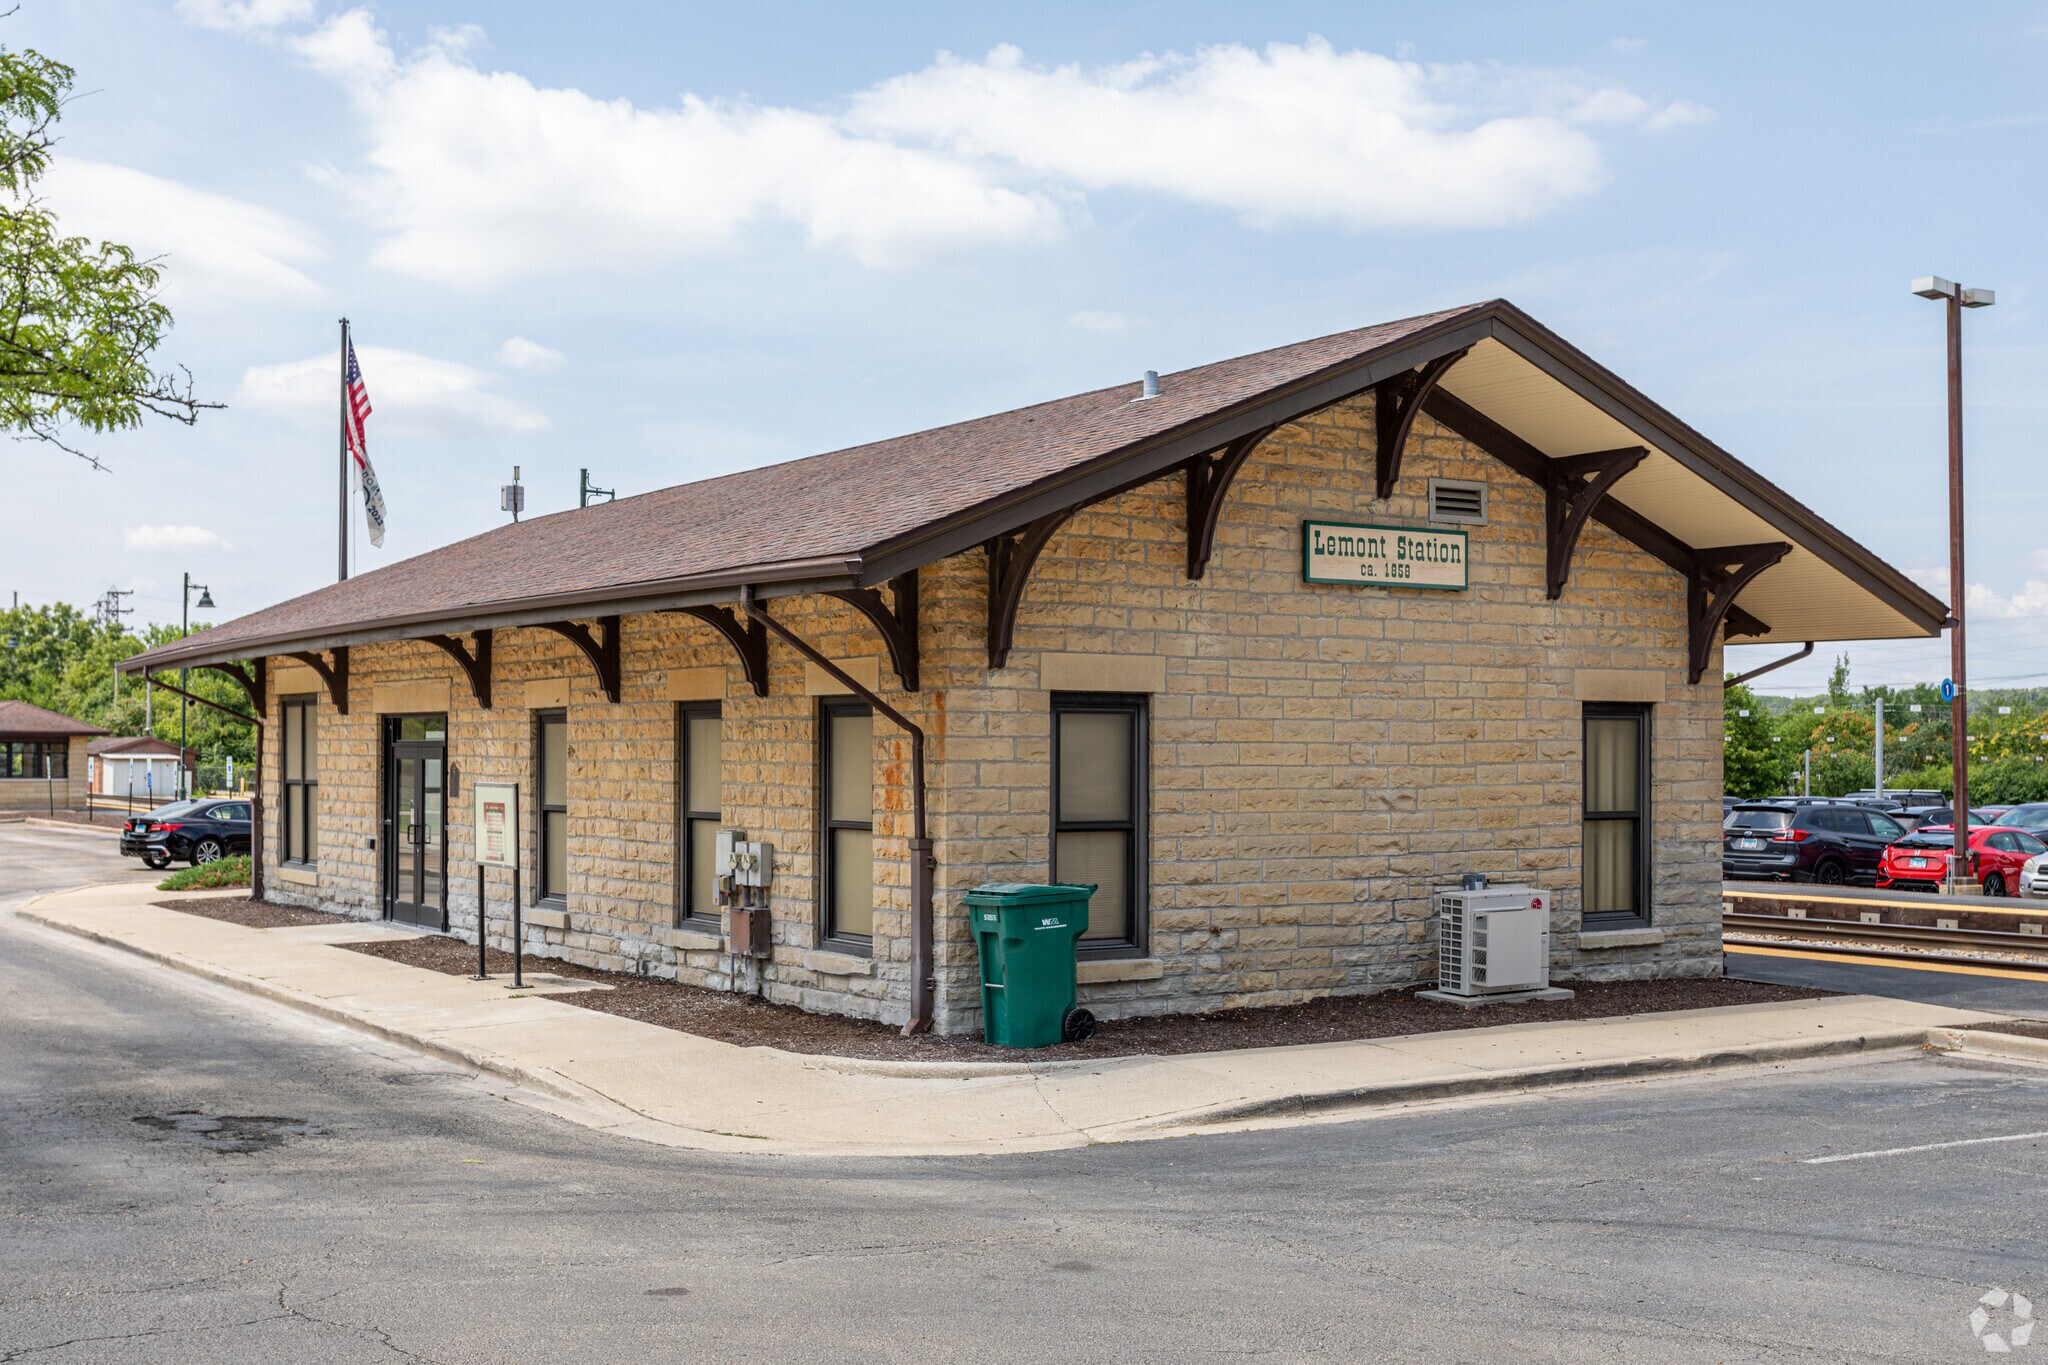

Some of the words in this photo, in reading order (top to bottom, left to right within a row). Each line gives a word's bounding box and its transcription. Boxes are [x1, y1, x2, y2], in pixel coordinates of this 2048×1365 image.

[368, 505, 383, 526] 2023
[1314, 530, 1386, 559] Lemont
[1397, 535, 1461, 564] Station
[1360, 564, 1377, 577] ca.
[1385, 562, 1411, 579] 1858
